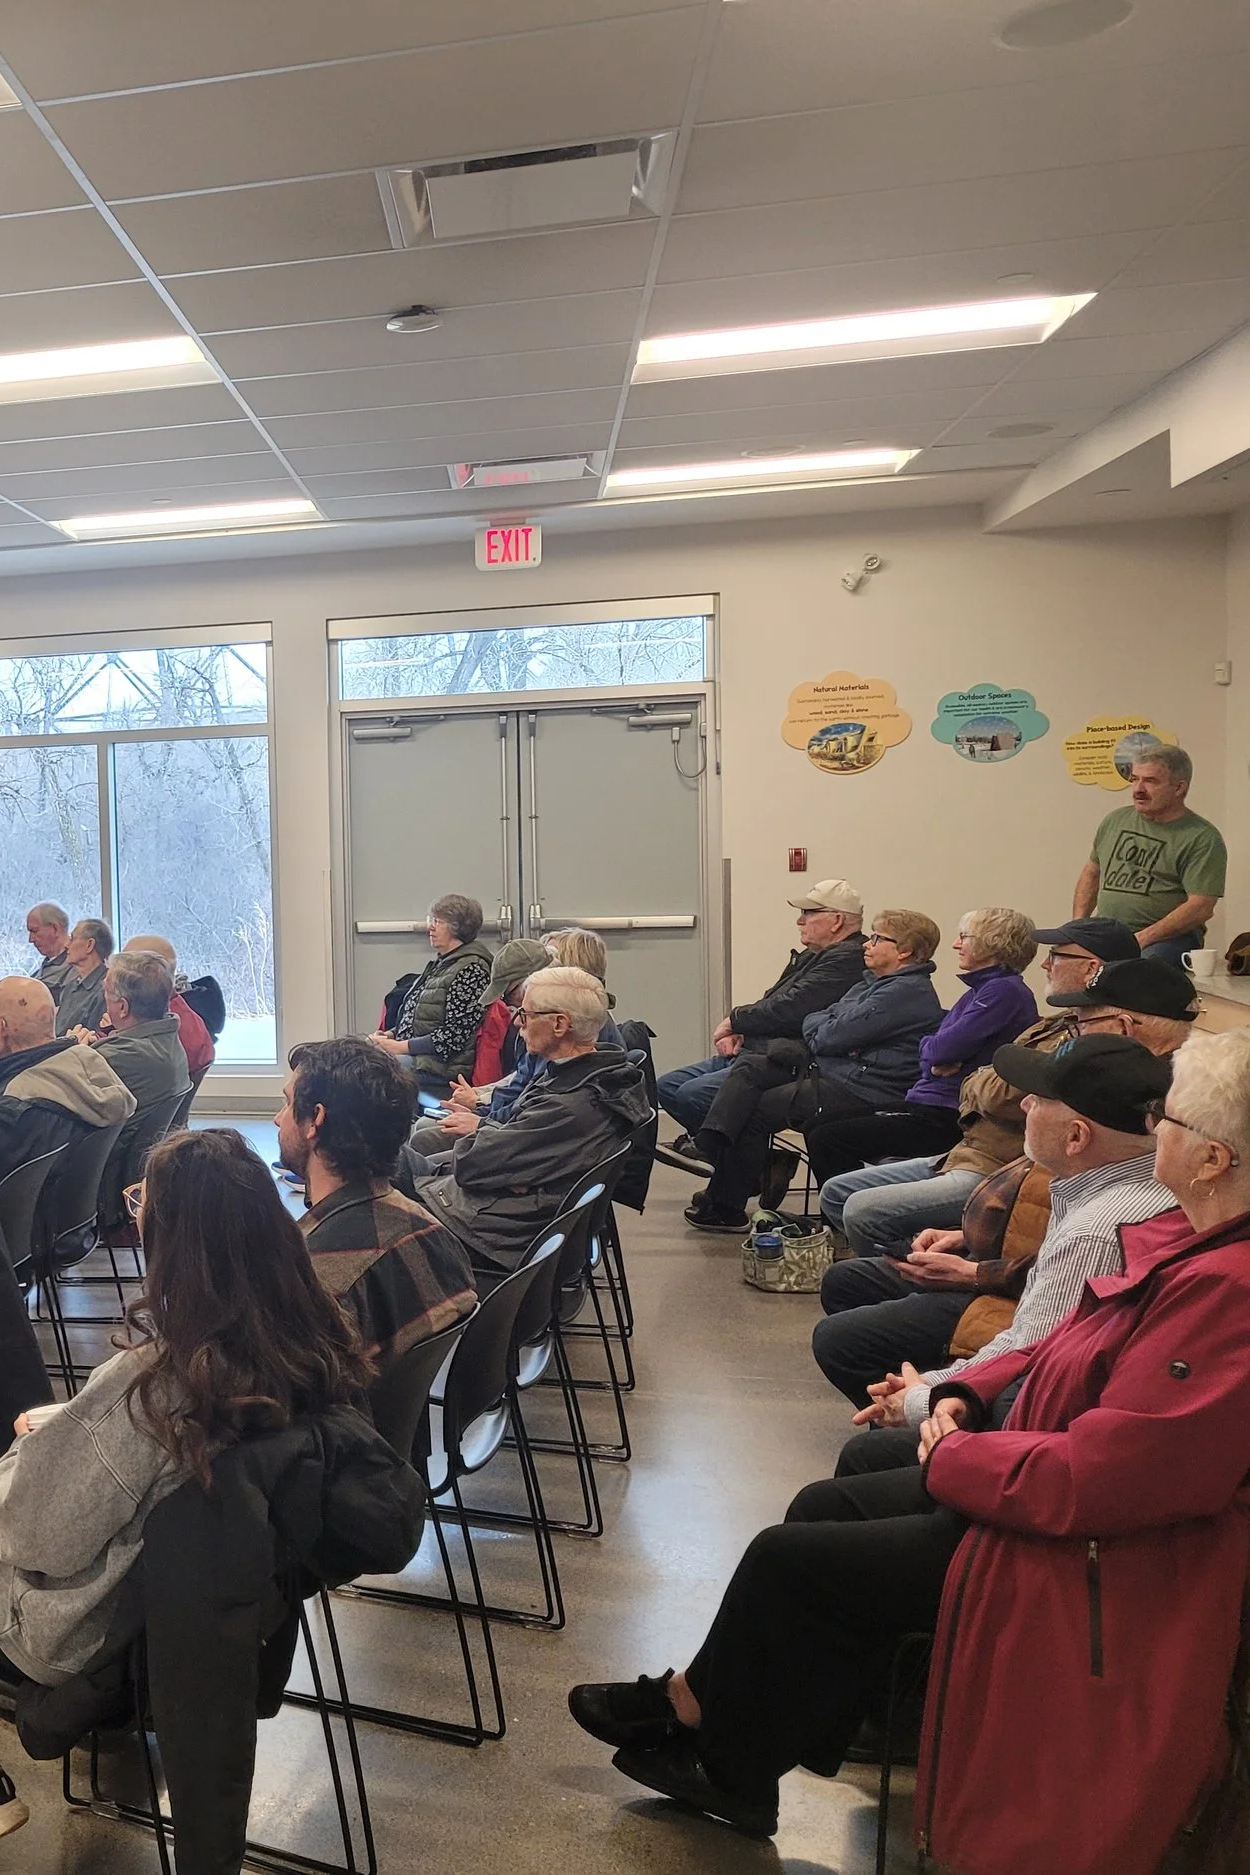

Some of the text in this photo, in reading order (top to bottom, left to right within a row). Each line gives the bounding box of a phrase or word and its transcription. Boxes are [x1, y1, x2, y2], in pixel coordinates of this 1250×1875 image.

[486, 528, 533, 564] EXIT
[839, 684, 870, 692] Materials
[1086, 723, 1151, 733] Place-based Design
[1106, 863, 1148, 889] dale
